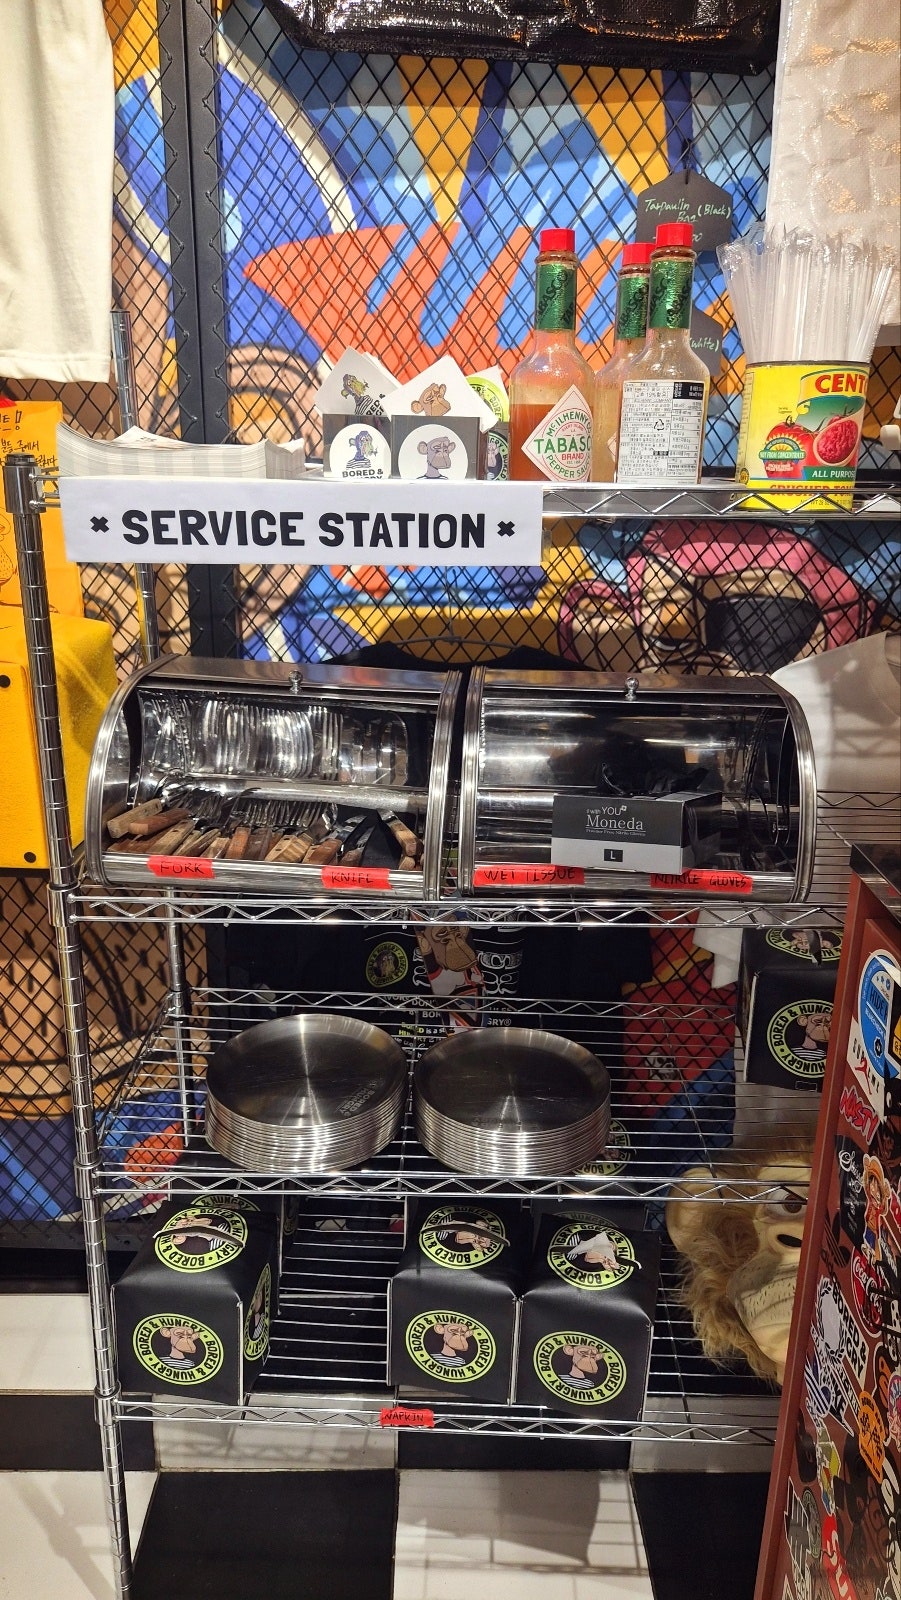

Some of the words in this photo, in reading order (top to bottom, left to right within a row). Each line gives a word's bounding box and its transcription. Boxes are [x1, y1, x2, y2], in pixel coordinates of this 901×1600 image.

[697, 204, 732, 219] (Black)
[815, 373, 868, 394] CENT
[342, 469, 377, 478] BORED
[377, 468, 384, 477] &
[546, 455, 575, 478] PEPPER
[121, 509, 305, 547] SERVICE
[318, 512, 486, 549] STATION
[602, 806, 621, 816] YOU
[585, 814, 644, 831] Moneda
[610, 850, 616, 860] L
[160, 861, 204, 875] FORK
[525, 867, 576, 881] TISSUE
[709, 875, 748, 888] GLOVES
[773, 1016, 789, 1051] BORED
[788, 1009, 799, 1019] &
[798, 1002, 833, 1014] HUNG
[168, 1251, 205, 1267] BORED
[434, 1249, 471, 1263] BORED
[564, 1266, 602, 1284] BORED
[411, 1322, 426, 1352] BORED
[423, 1317, 434, 1325] &
[433, 1314, 480, 1331] HUNGRY
[832, 1283, 860, 1348] BORED
[859, 1343, 867, 1365] &
[138, 1327, 151, 1356] BORED
[148, 1320, 160, 1329] &
[159, 1317, 204, 1334] HUNGRY
[205, 1340, 220, 1370] BORED
[475, 1338, 491, 1369] BORED
[539, 1342, 555, 1372] BORED
[552, 1337, 564, 1346] &
[563, 1335, 611, 1354] HUNGRY
[151, 1362, 197, 1381] HUNGRY
[195, 1367, 207, 1377] &
[421, 1358, 466, 1378] HUNGRY
[465, 1365, 477, 1375] &
[604, 1361, 620, 1392] BORED
[549, 1379, 595, 1400] HUNGRY
[594, 1388, 606, 1398] &
[384, 1411, 424, 1422] NAPKIN
